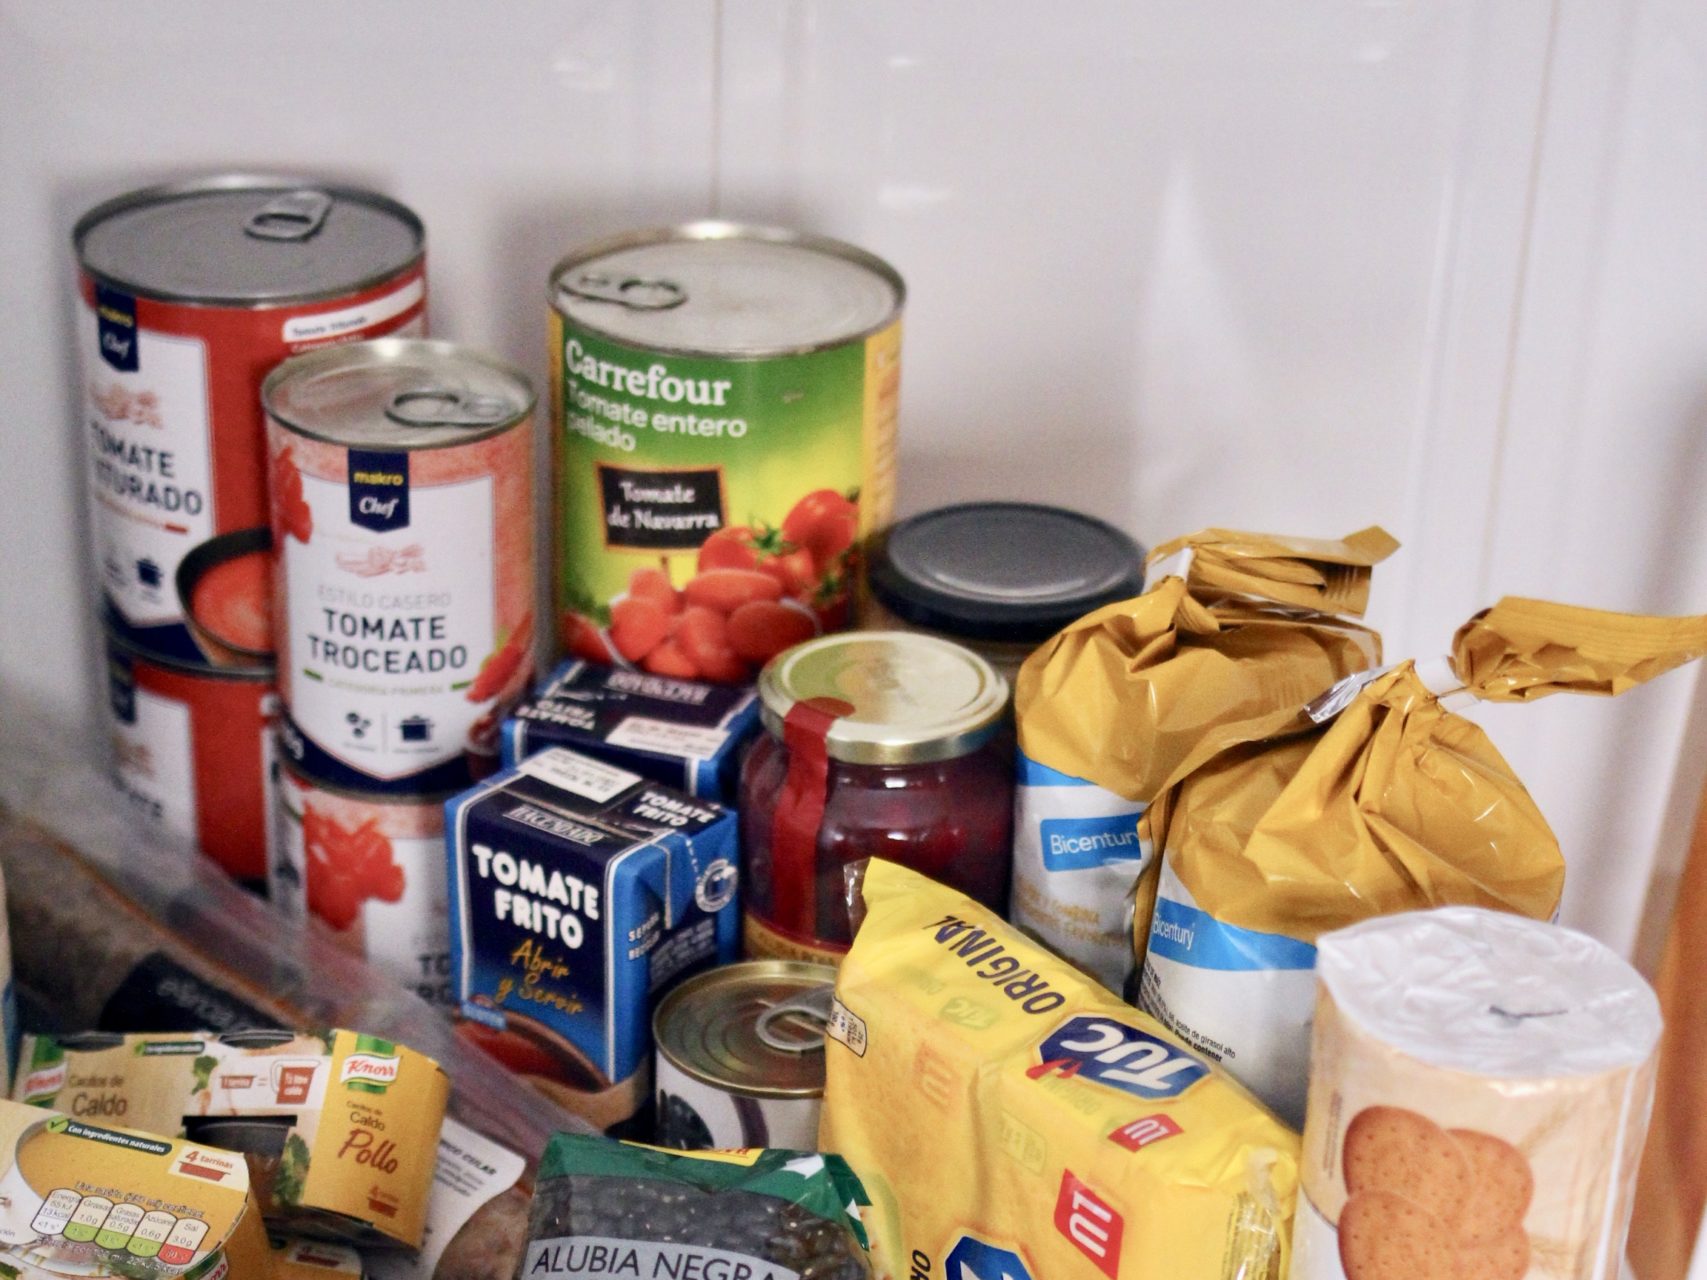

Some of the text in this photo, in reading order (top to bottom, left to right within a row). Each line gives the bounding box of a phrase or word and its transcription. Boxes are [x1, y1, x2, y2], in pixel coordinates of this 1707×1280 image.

[565, 338, 732, 406] Carrefour
[652, 411, 748, 438] entero
[353, 471, 404, 486] makro
[618, 480, 696, 503] Tomate
[358, 496, 399, 519] Chef
[607, 503, 721, 530] de Navarra
[323, 607, 446, 641] TOMATE
[307, 633, 468, 674] TROCEADO
[632, 804, 690, 827] FRITO
[640, 790, 716, 824] TOMATE
[471, 844, 600, 921] TOMATE
[493, 888, 584, 950] FRITO
[1153, 912, 1195, 951] Bicentury
[511, 938, 570, 979] Abrir
[930, 910, 1067, 1015] ORIGINAL
[346, 1058, 397, 1077] Knorr
[1060, 1023, 1206, 1092] TUC
[71, 1091, 129, 1117] Caldo
[350, 1110, 386, 1133] Caldo
[1123, 1120, 1169, 1146] LU
[185, 1150, 200, 1164] 4
[337, 1127, 400, 1176] Pollo
[1069, 1189, 1114, 1259] LU
[531, 1245, 641, 1276] ALUBIA
